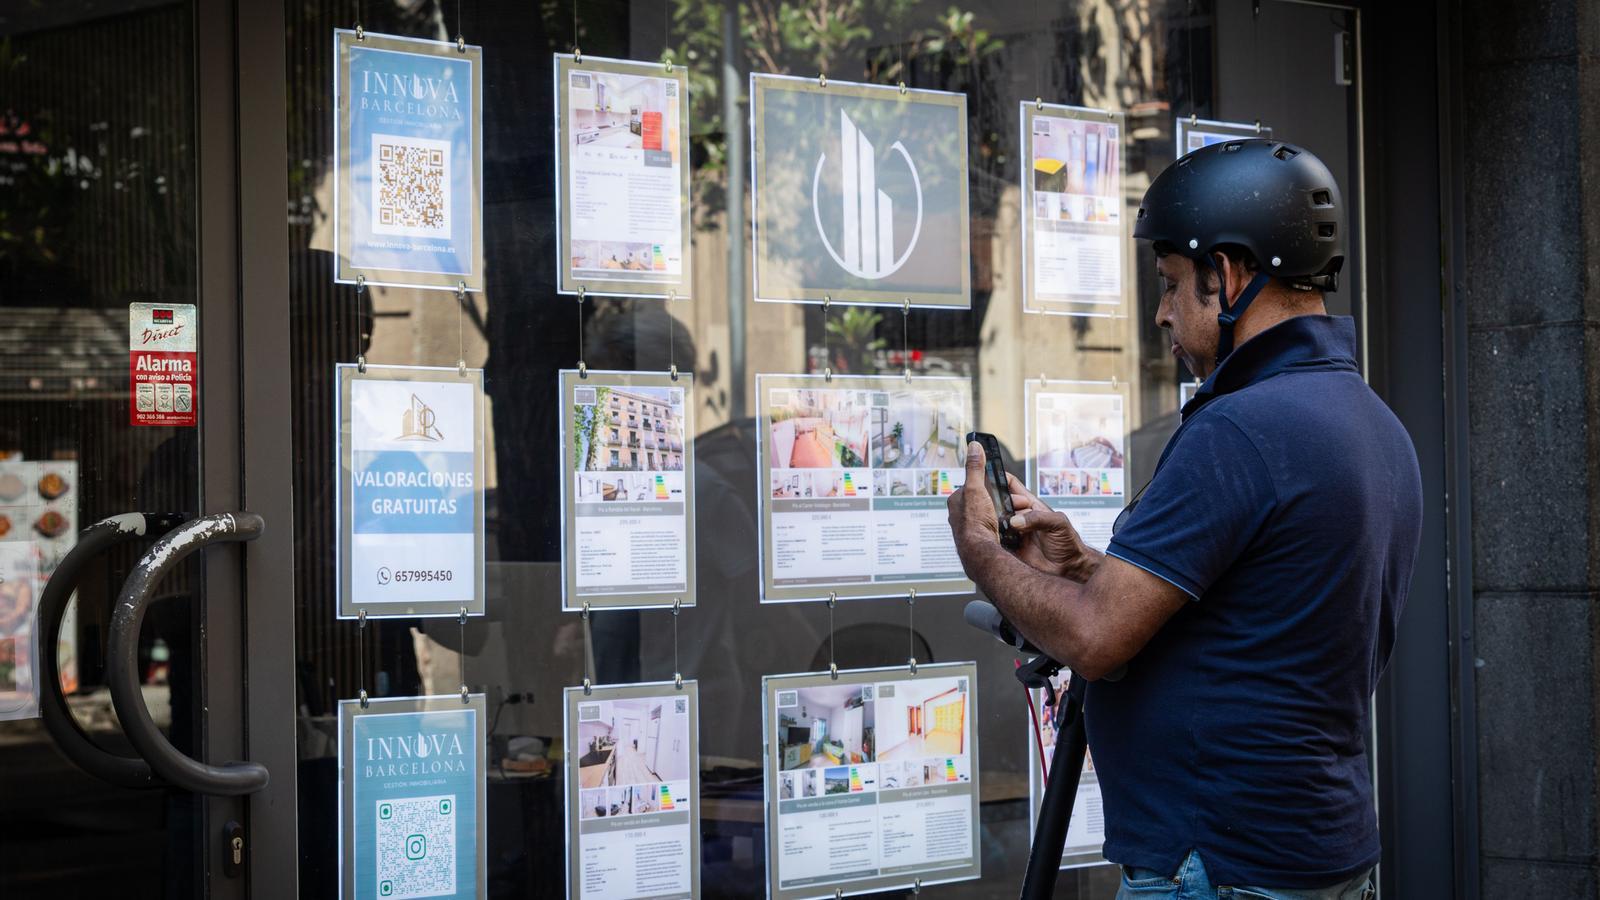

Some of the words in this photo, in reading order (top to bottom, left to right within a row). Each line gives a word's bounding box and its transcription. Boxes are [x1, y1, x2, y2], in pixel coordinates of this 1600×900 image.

[361, 97, 461, 120] BARCELONA
[142, 325, 185, 344] Direct
[136, 354, 192, 372] Alarma
[148, 373, 165, 381] aviso
[171, 373, 192, 381] Policía
[354, 471, 473, 487] VALORACIONES
[372, 498, 457, 514] GRATUITAS
[395, 570, 452, 582] 657995450
[365, 760, 466, 778] BARCELONA
